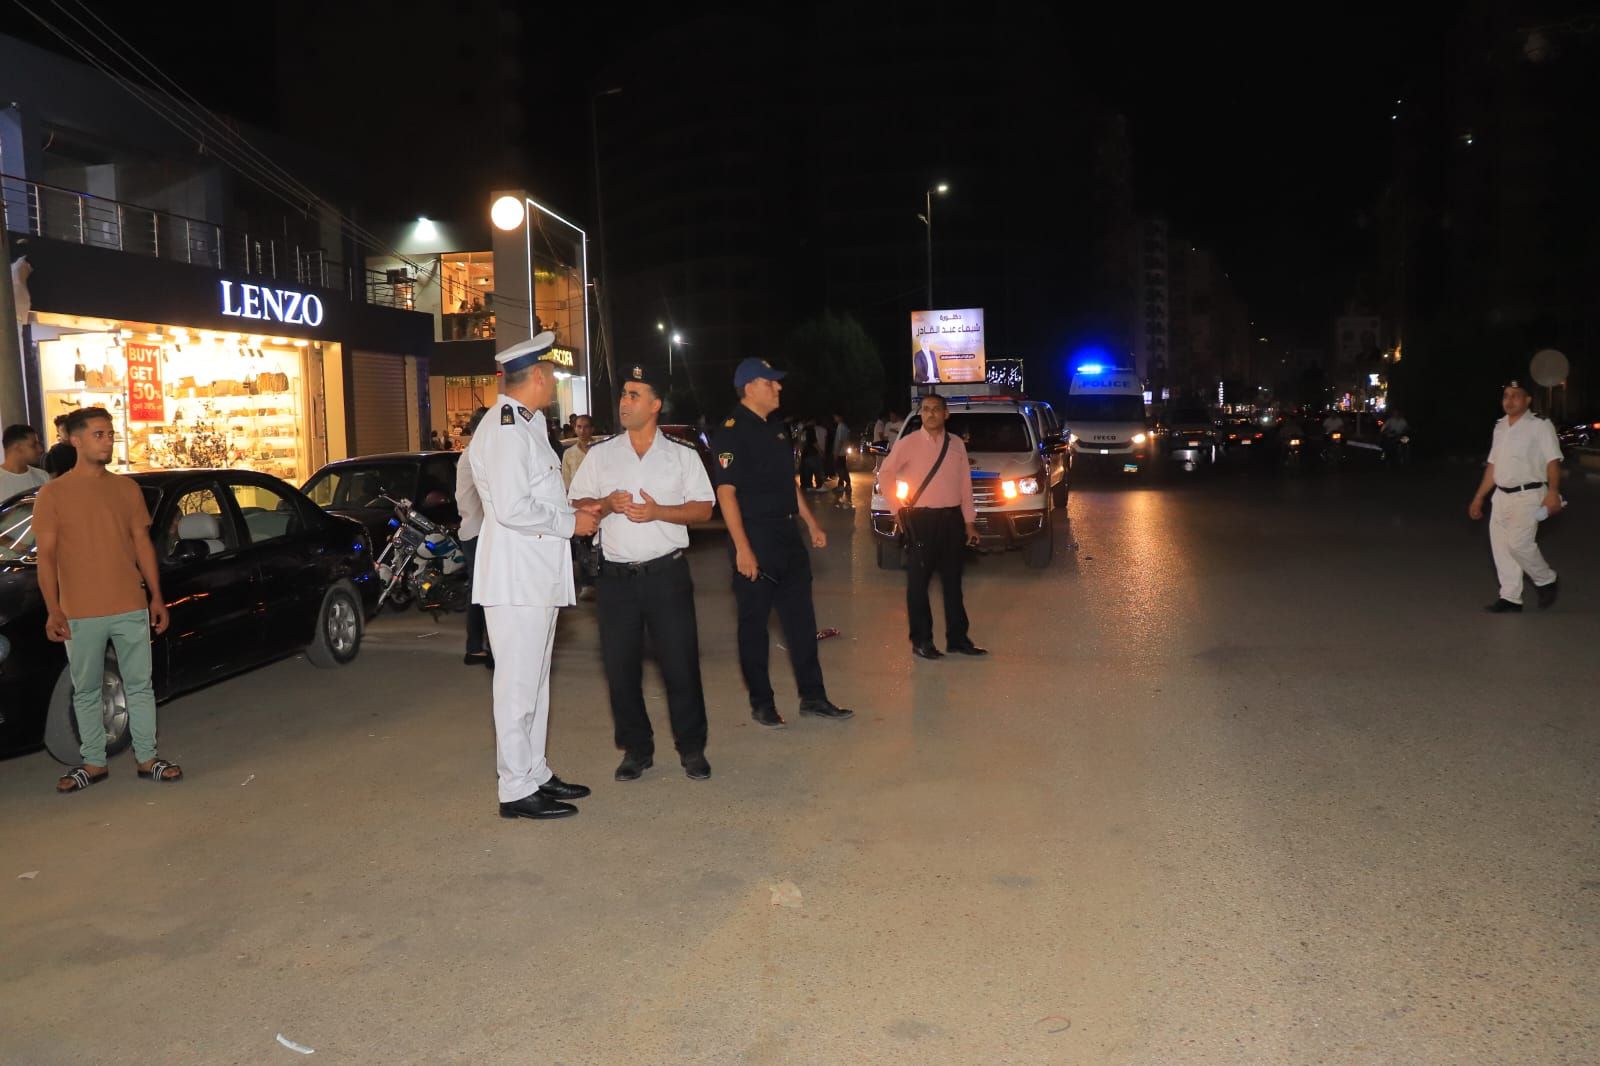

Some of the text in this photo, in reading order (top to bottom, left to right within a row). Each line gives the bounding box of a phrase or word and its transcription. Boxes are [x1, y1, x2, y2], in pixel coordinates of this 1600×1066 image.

[220, 280, 324, 327] LENZO
[915, 323, 981, 337] شيماء عبد القادر
[129, 347, 161, 381] BUY 1
[129, 365, 153, 381] GET
[133, 382, 161, 400] 50%
[1082, 380, 1130, 388] POLICE
